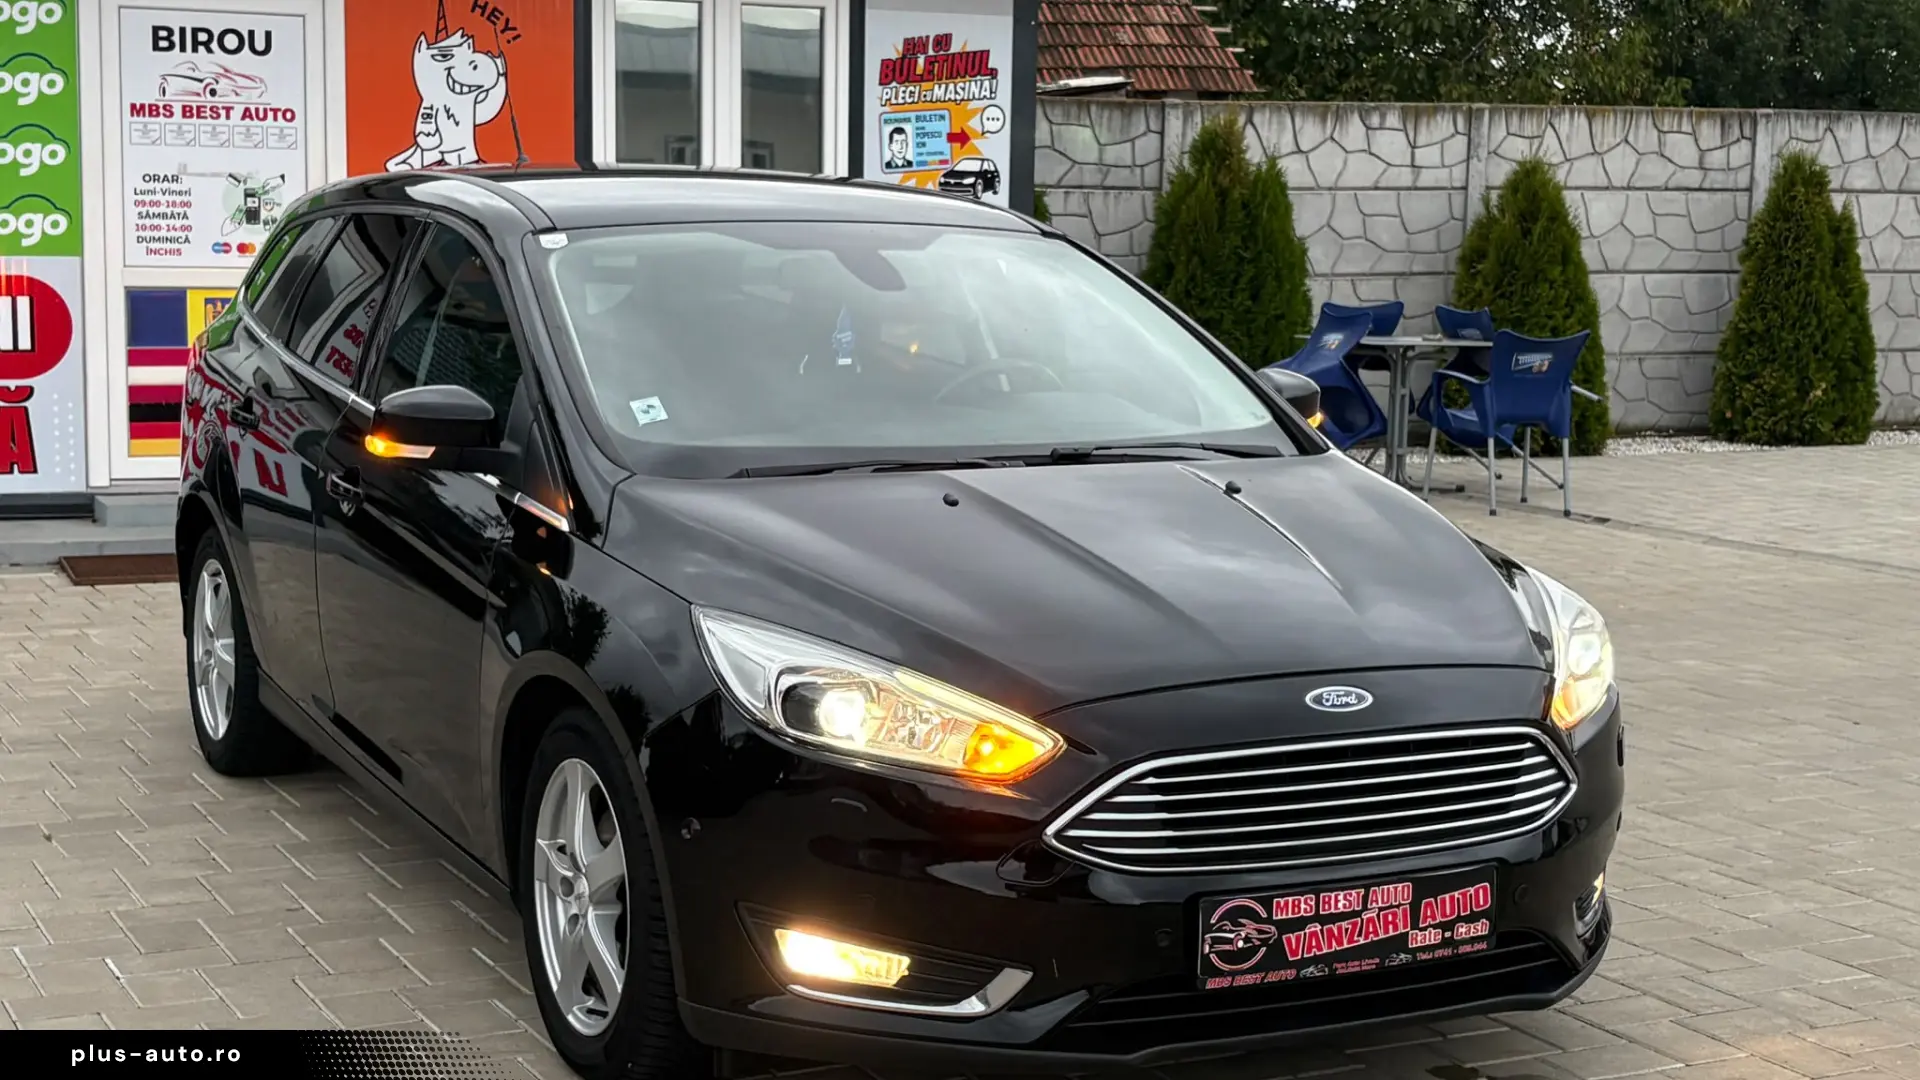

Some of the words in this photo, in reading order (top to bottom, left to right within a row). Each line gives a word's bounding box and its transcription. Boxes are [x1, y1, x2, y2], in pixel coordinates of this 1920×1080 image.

[470, 0, 522, 44] HEY!
[151, 25, 273, 57] BIROU
[903, 35, 930, 55] HAI
[932, 33, 953, 53] CU
[879, 49, 998, 86] BULETINUL,
[880, 85, 921, 107] PLECI
[932, 79, 998, 105] MAȘINA!
[129, 102, 175, 119] MBS
[181, 104, 235, 121] BEST
[240, 106, 297, 123] AUTO
[915, 113, 946, 124] BULETIN
[142, 173, 183, 185] ORAR:
[134, 187, 192, 197] Luni-Vineri
[134, 199, 192, 209] 09:00-18:00
[0, 212, 68, 247] ogo
[135, 223, 193, 233] 10:00-14:00
[145, 245, 183, 257] ÎNCHIS
[1322, 691, 1358, 706] Ford
[1273, 894, 1316, 920] MBS
[1319, 889, 1365, 915] BEST
[1367, 882, 1413, 909] AUTO
[1282, 904, 1411, 961] VÂNZĂRI
[1419, 882, 1492, 928] AUTO
[1408, 928, 1442, 948] Rate
[1453, 918, 1490, 940] Cash
[1205, 976, 1233, 990] MBS
[1232, 972, 1266, 987] BEST
[1263, 968, 1298, 983] AUTO
